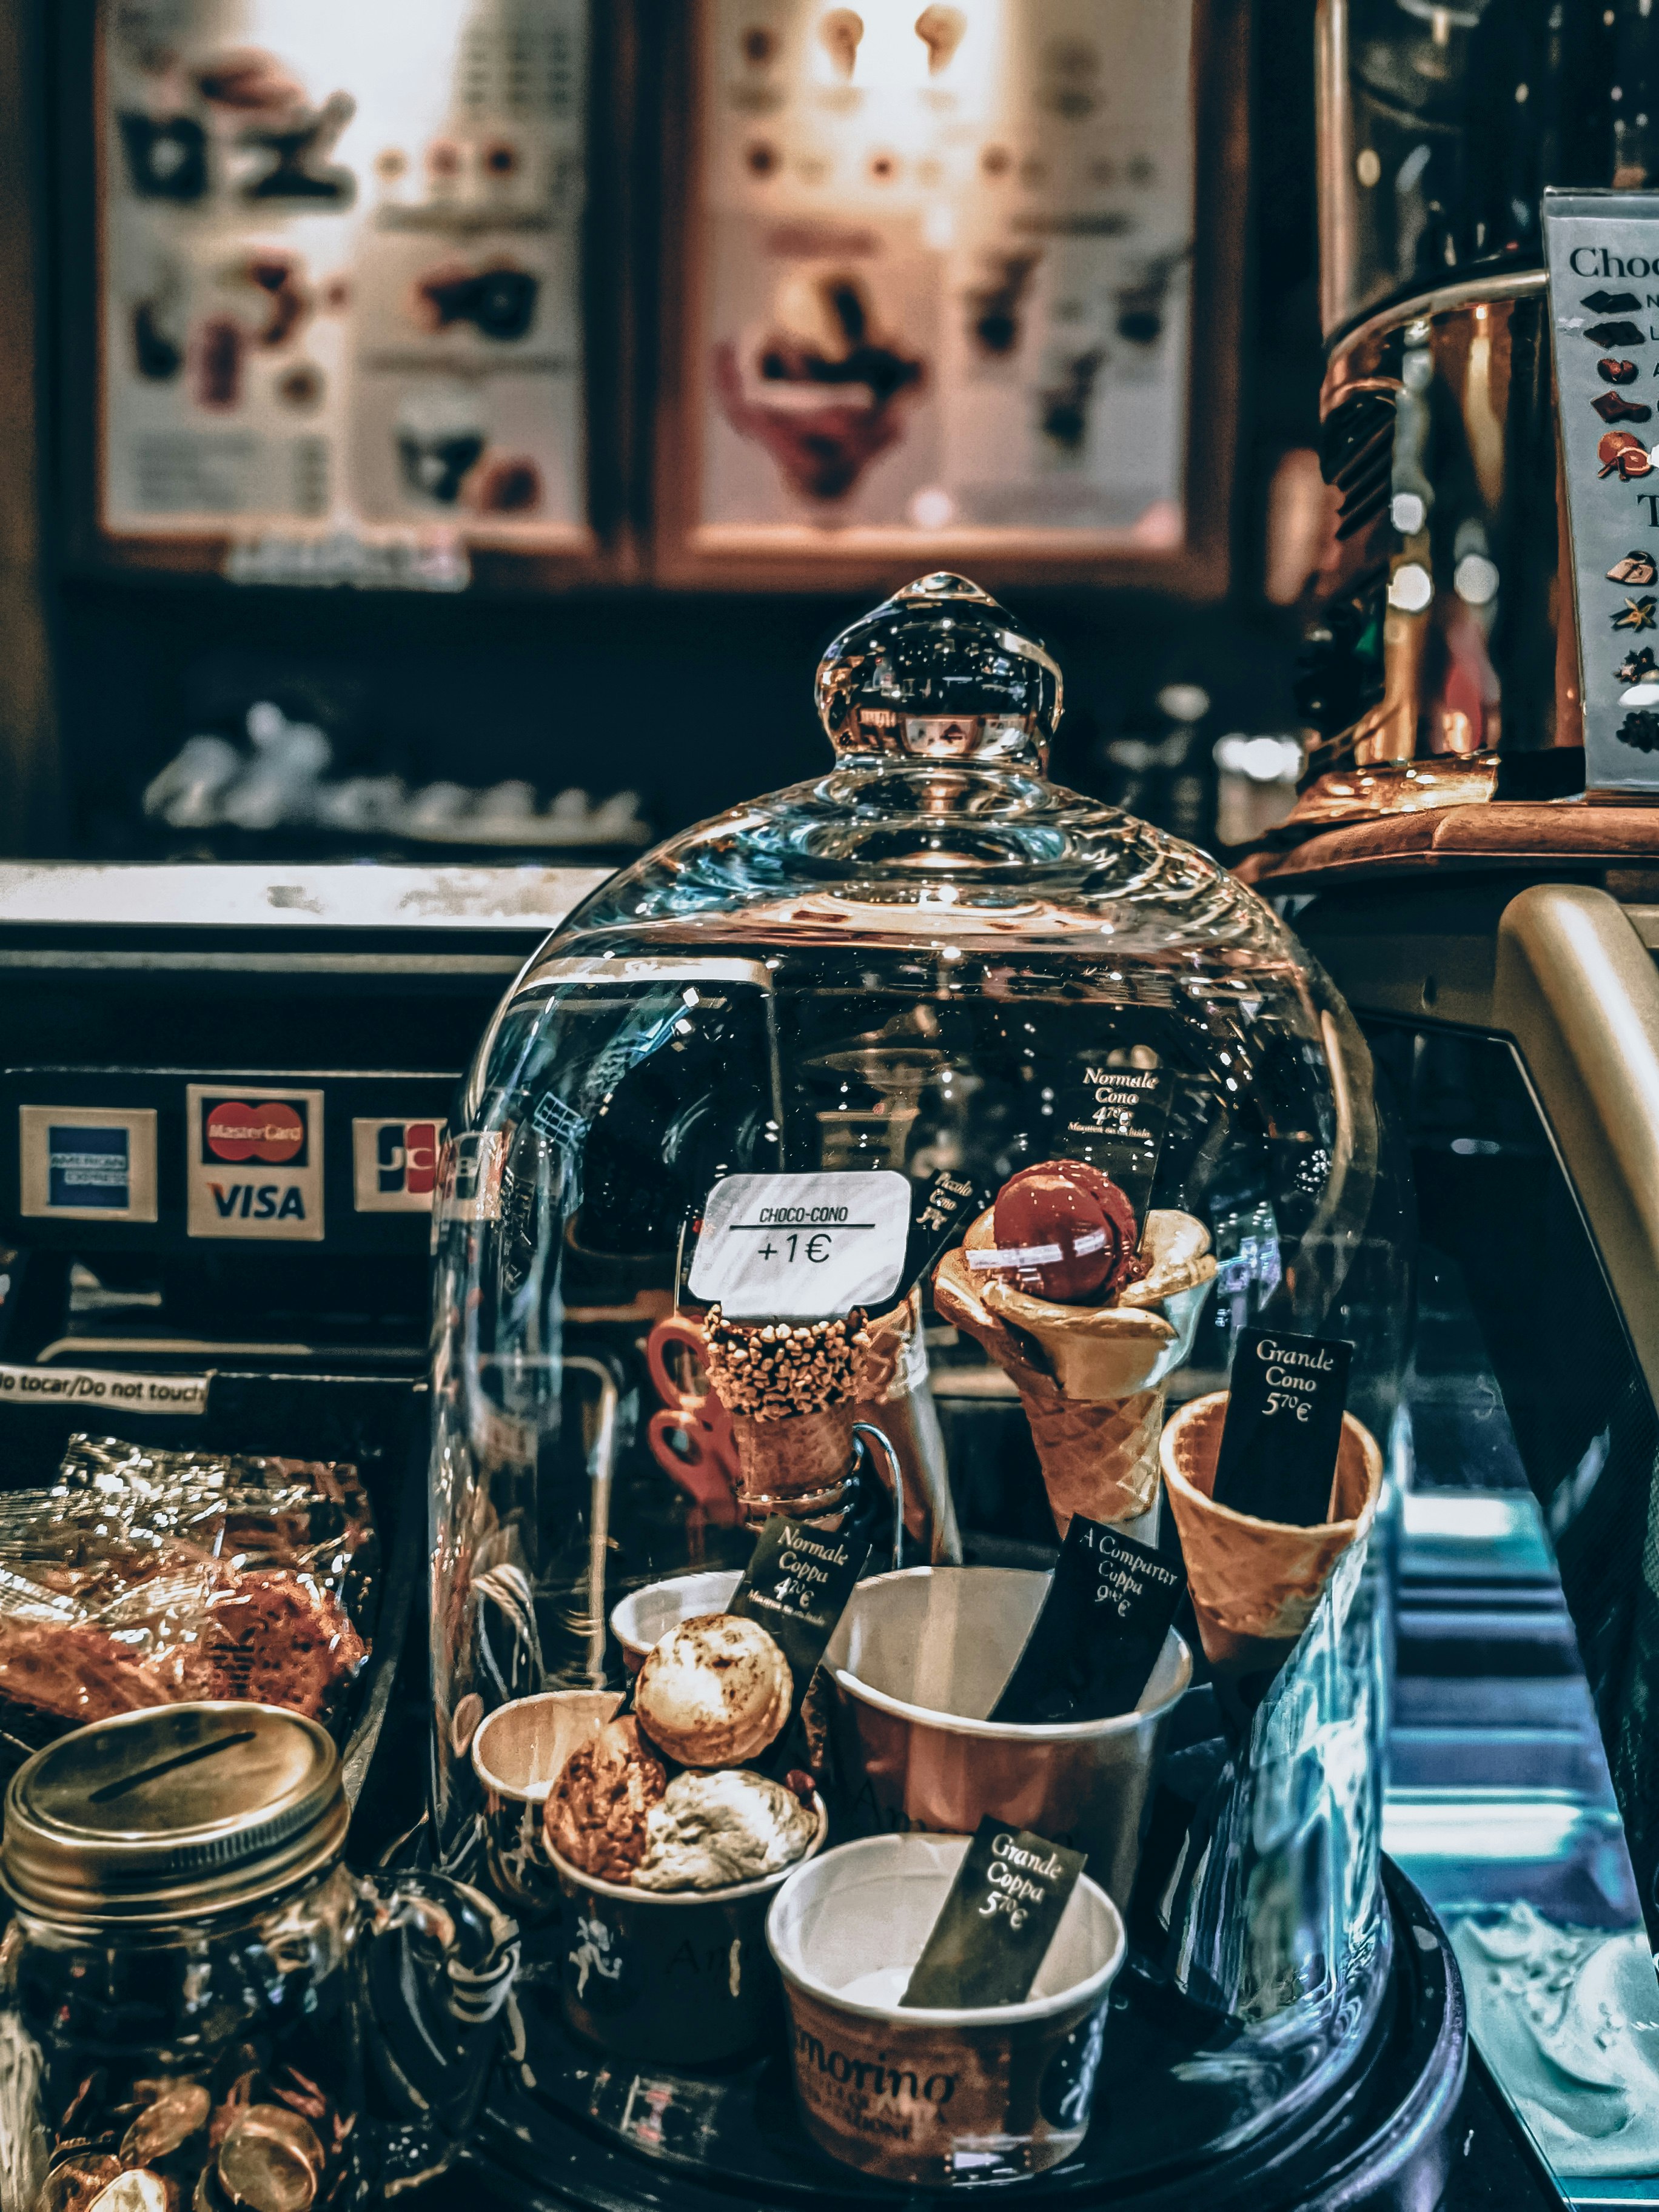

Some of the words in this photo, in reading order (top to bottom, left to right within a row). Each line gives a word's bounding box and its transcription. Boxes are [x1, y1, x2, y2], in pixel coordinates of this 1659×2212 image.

[1082, 1067, 1159, 1090] Normale
[1095, 1087, 1140, 1105] Cono
[207, 1181, 306, 1221] VISA
[759, 1206, 850, 1224] CHOCO-CONO
[1256, 1339, 1334, 1371] Grande
[0, 1372, 16, 1391] o
[111, 1382, 143, 1399] not
[149, 1383, 207, 1401] touch
[1265, 1366, 1318, 1392] Cono
[777, 1525, 850, 1566] Normale
[991, 1832, 1064, 1880] Grande
[987, 1860, 1046, 1905] Coppa
